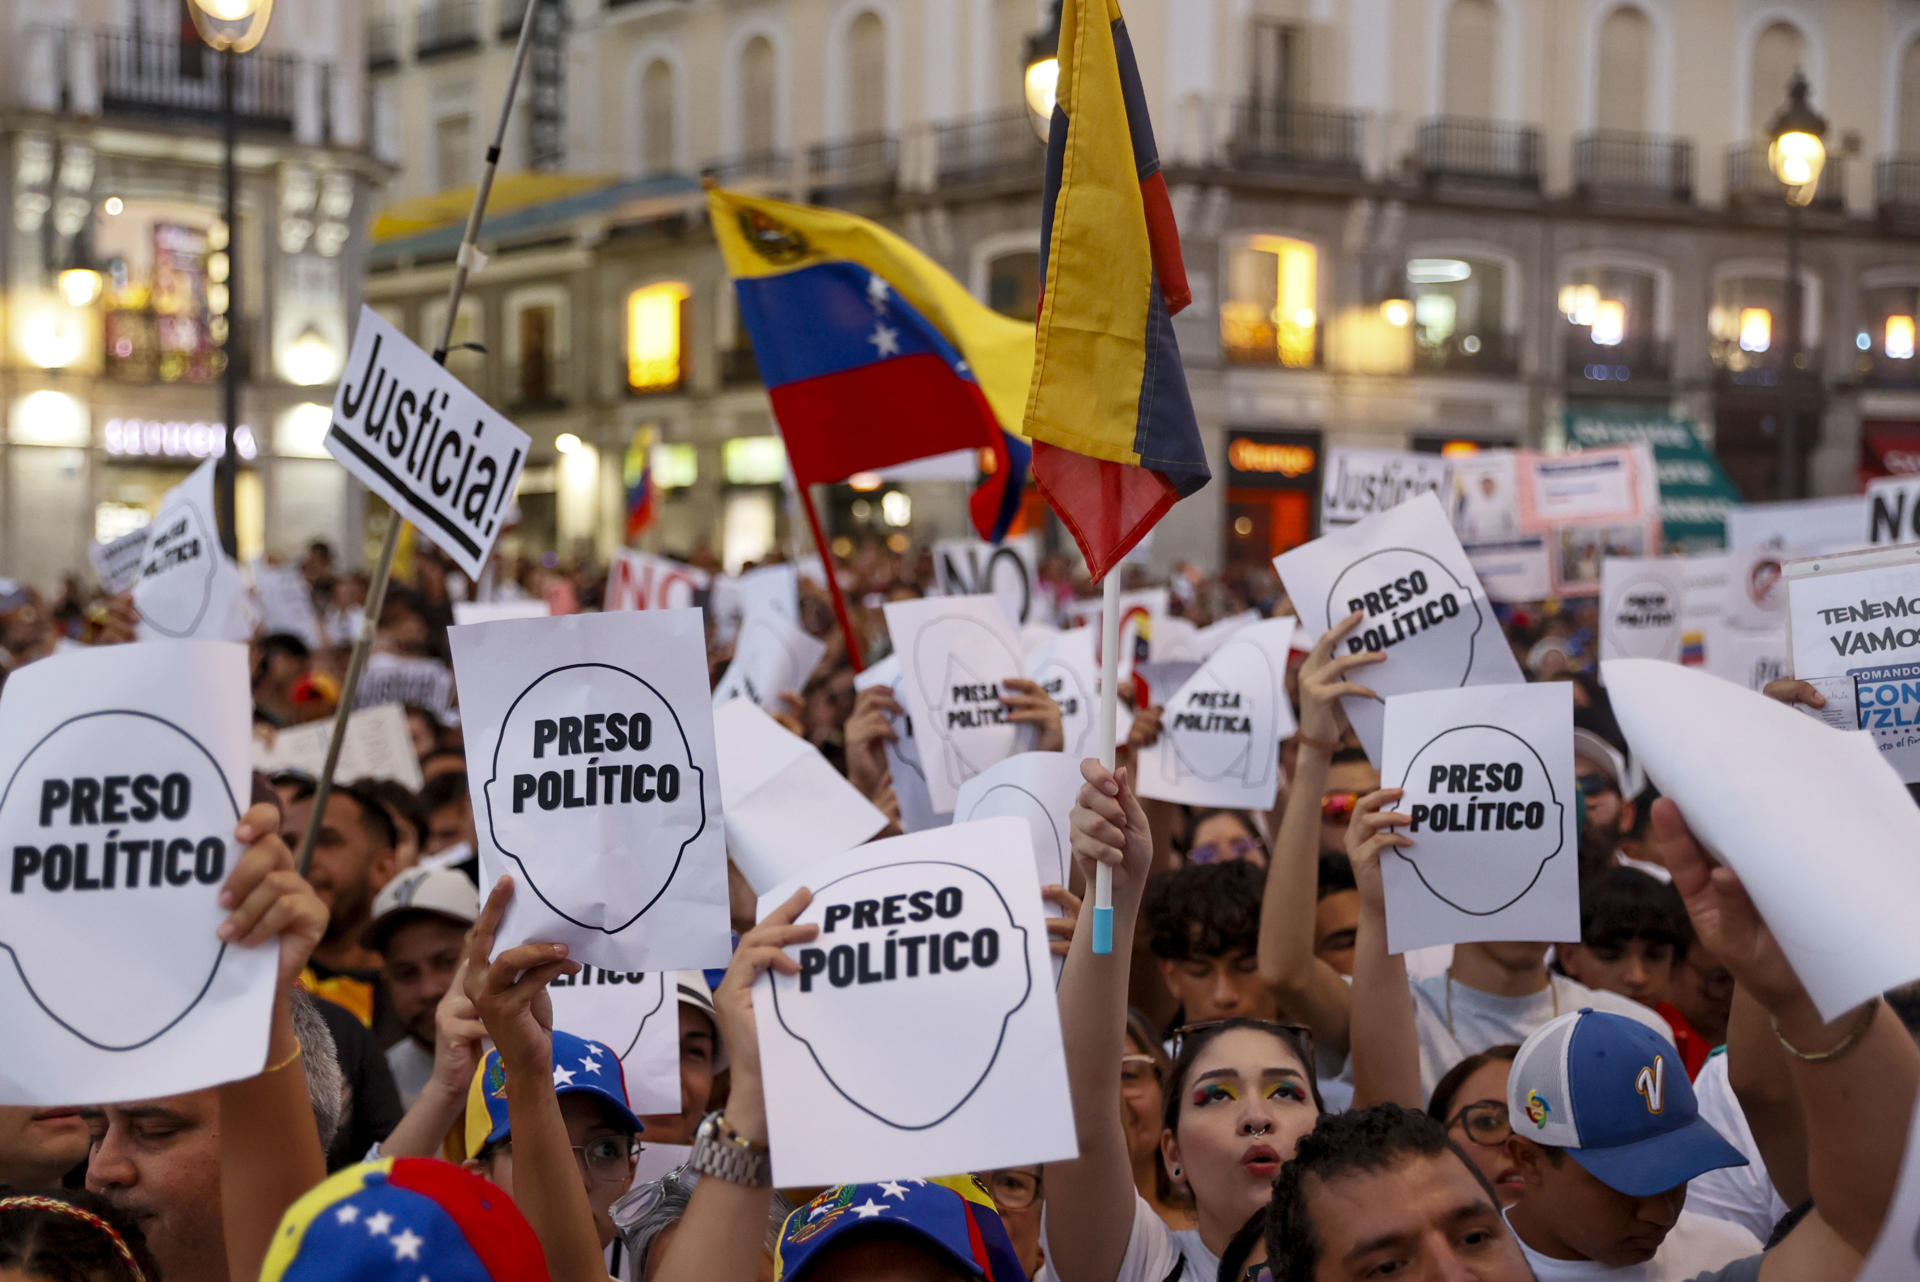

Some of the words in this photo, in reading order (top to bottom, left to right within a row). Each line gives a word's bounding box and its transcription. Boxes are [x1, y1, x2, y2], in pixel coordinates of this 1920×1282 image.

[341, 333, 521, 537] Justicia!
[1348, 570, 1428, 617] PRESO
[1347, 593, 1459, 655] POLÍTICO
[1830, 626, 1920, 657] VAMO
[952, 684, 999, 704] PRESA
[1187, 691, 1241, 708] PRESA
[534, 713, 651, 758] PRESO
[39, 773, 191, 827] PRESO
[512, 757, 680, 814] POLÍTICO
[1428, 762, 1524, 794] PRESO
[1409, 796, 1545, 832] POLÍTICO
[10, 830, 226, 894] POLÍTICO
[823, 886, 963, 934] PRESO
[799, 928, 1000, 993] POLÍTICO
